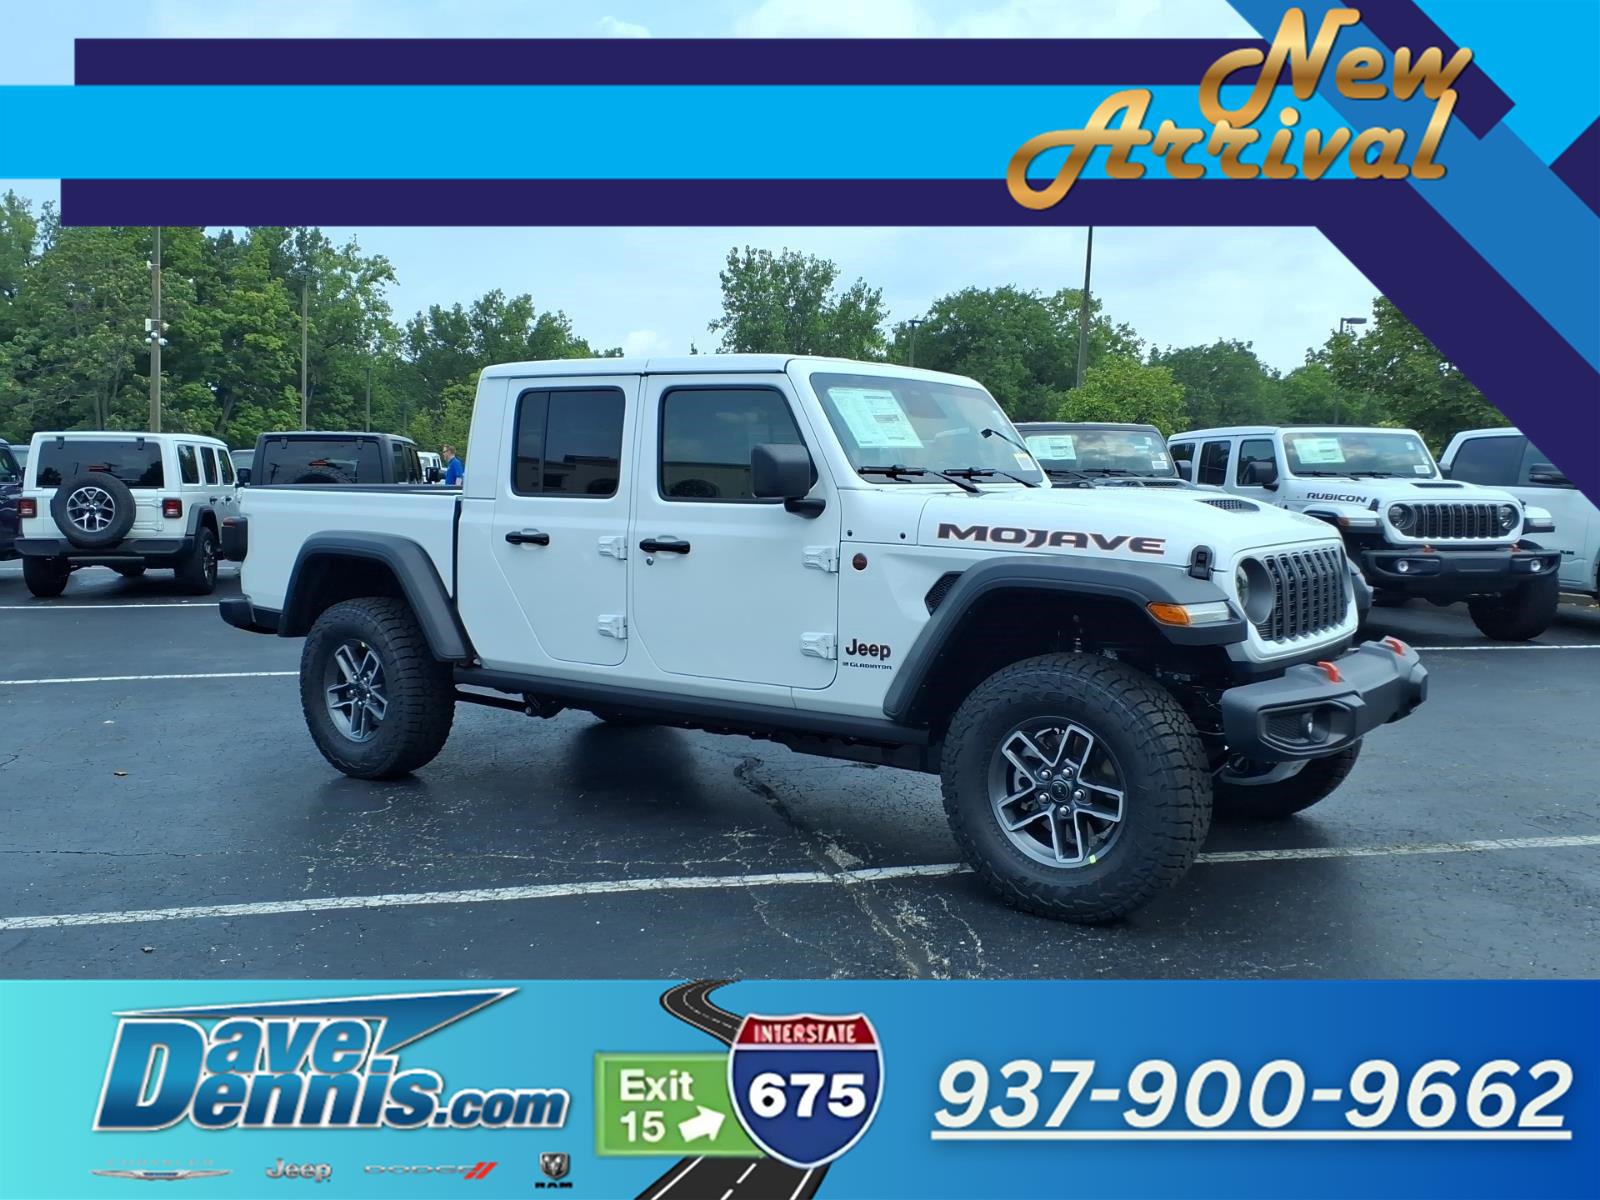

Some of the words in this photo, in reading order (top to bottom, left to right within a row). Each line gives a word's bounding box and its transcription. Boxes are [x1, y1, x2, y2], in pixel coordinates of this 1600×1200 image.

[1306, 492, 1367, 503] RUBICON
[937, 522, 1166, 555] MOJAVE
[845, 638, 891, 661] Jeep
